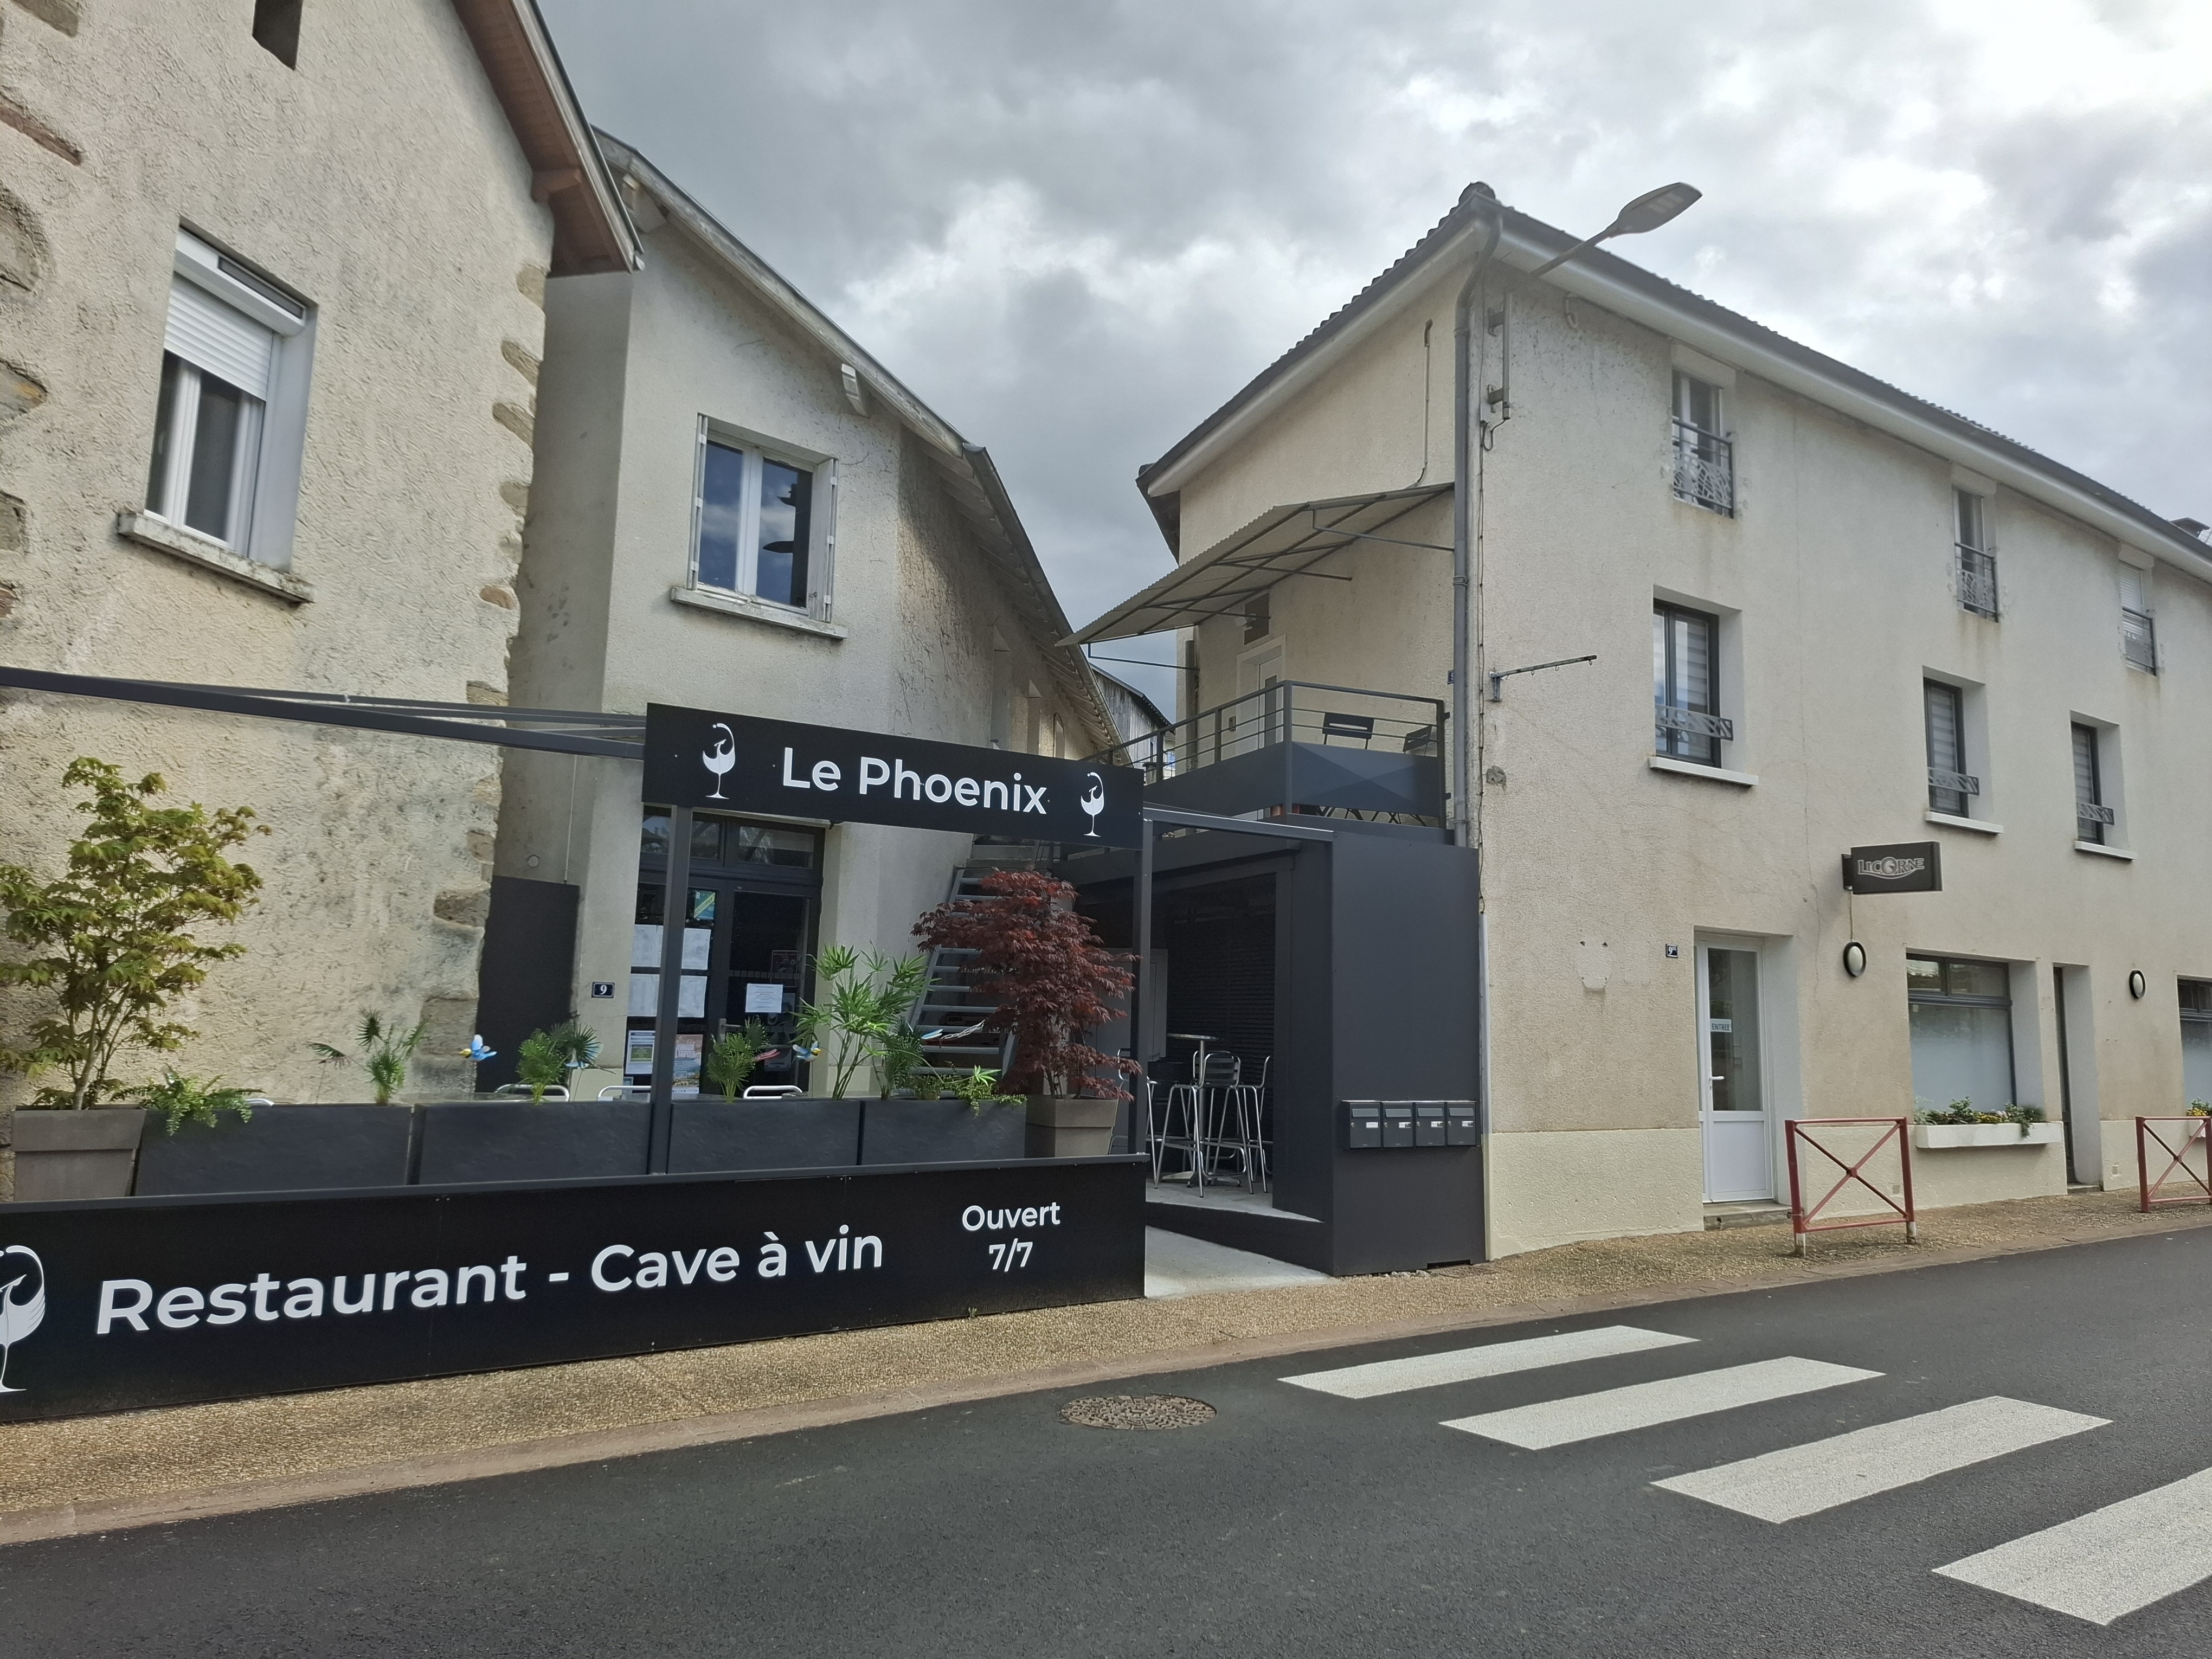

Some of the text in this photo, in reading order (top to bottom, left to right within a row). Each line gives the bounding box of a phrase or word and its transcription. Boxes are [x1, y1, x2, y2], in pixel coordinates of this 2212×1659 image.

[783, 747, 1047, 814] Le Phoenix
[1857, 857, 1925, 879] LICORNE
[600, 985, 607, 995] 9
[962, 1203, 1061, 1231] Ouvert
[989, 1238, 1033, 1272] 7/7
[97, 1255, 527, 1335] Restaurant
[591, 1244, 740, 1292] Cave
[758, 1231, 787, 1278] à
[805, 1224, 882, 1273] vin
